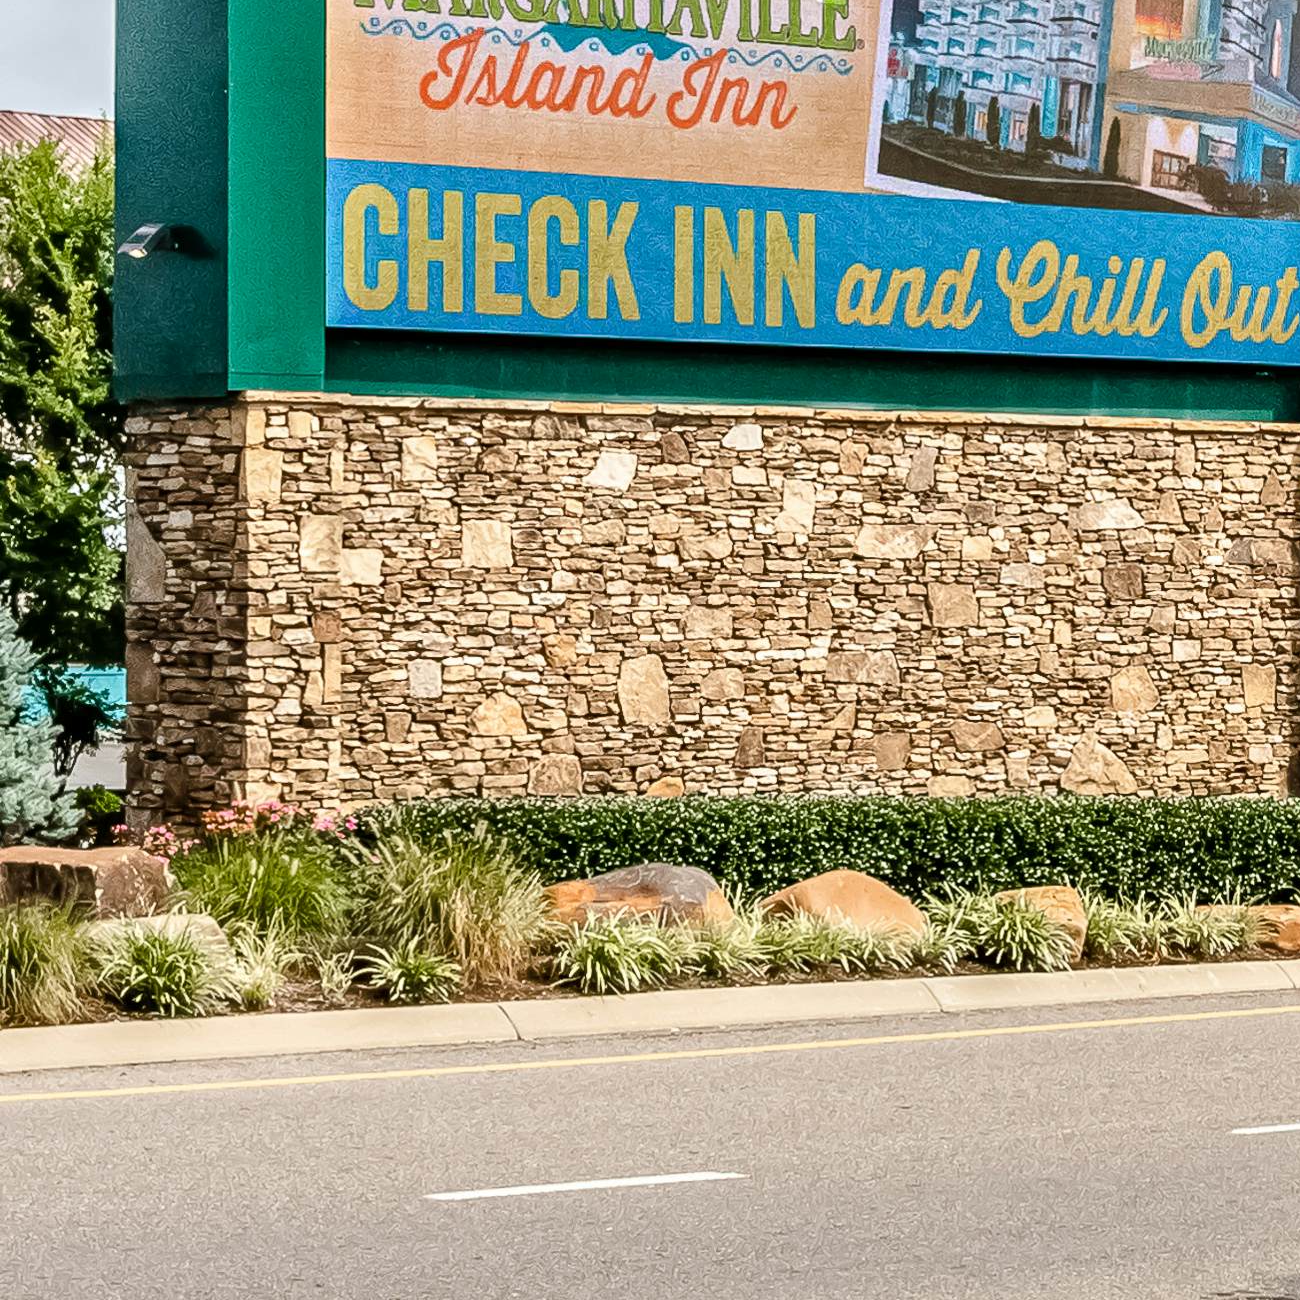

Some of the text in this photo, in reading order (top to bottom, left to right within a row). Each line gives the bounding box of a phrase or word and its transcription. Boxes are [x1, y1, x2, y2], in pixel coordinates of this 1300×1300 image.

[419, 27, 798, 130] Island Inn
[342, 182, 1300, 349] CHECK INN and Chill Out
